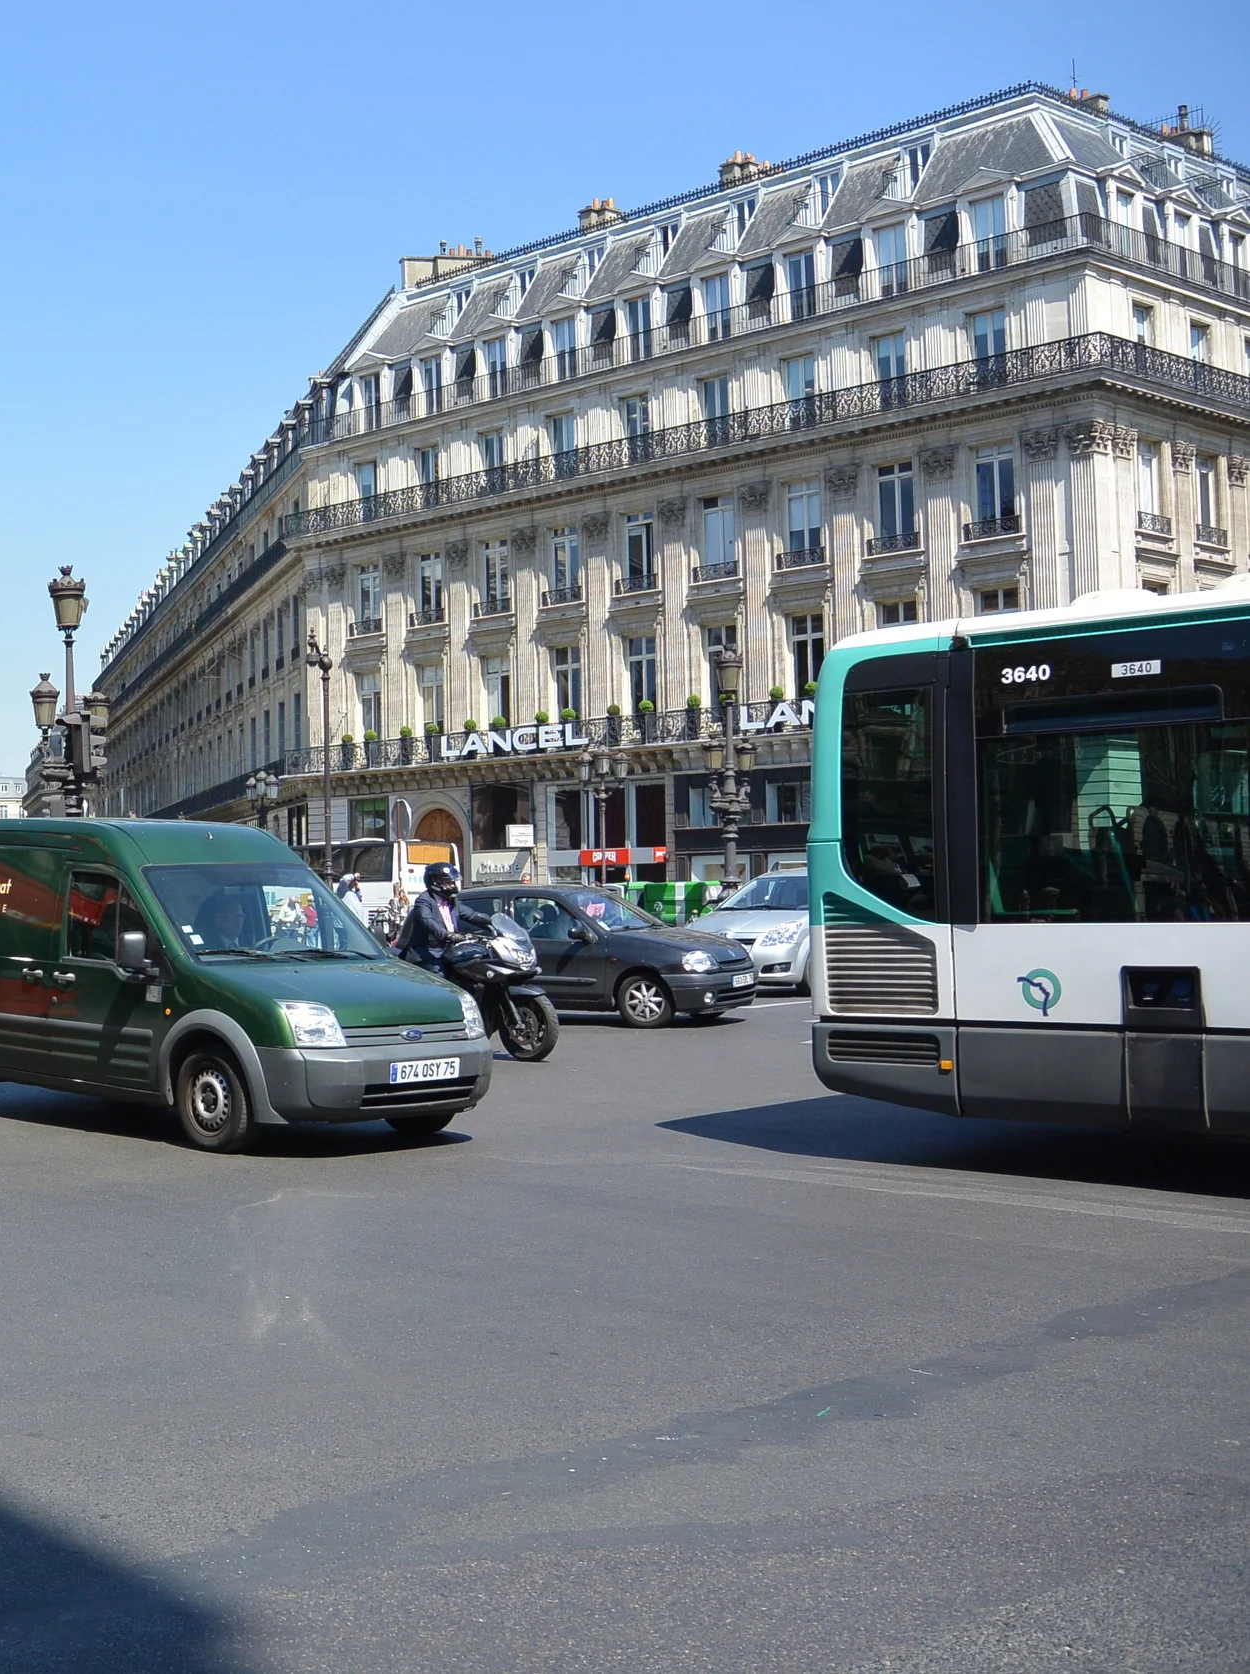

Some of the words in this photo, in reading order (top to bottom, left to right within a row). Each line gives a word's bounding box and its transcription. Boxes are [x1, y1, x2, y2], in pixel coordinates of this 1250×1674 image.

[1001, 664, 1050, 684] 3640
[1120, 661, 1152, 676] 3640
[440, 723, 590, 758] LANCEL
[478, 860, 521, 876] Change
[400, 1064, 419, 1080] 674
[443, 1060, 456, 1076] 75
